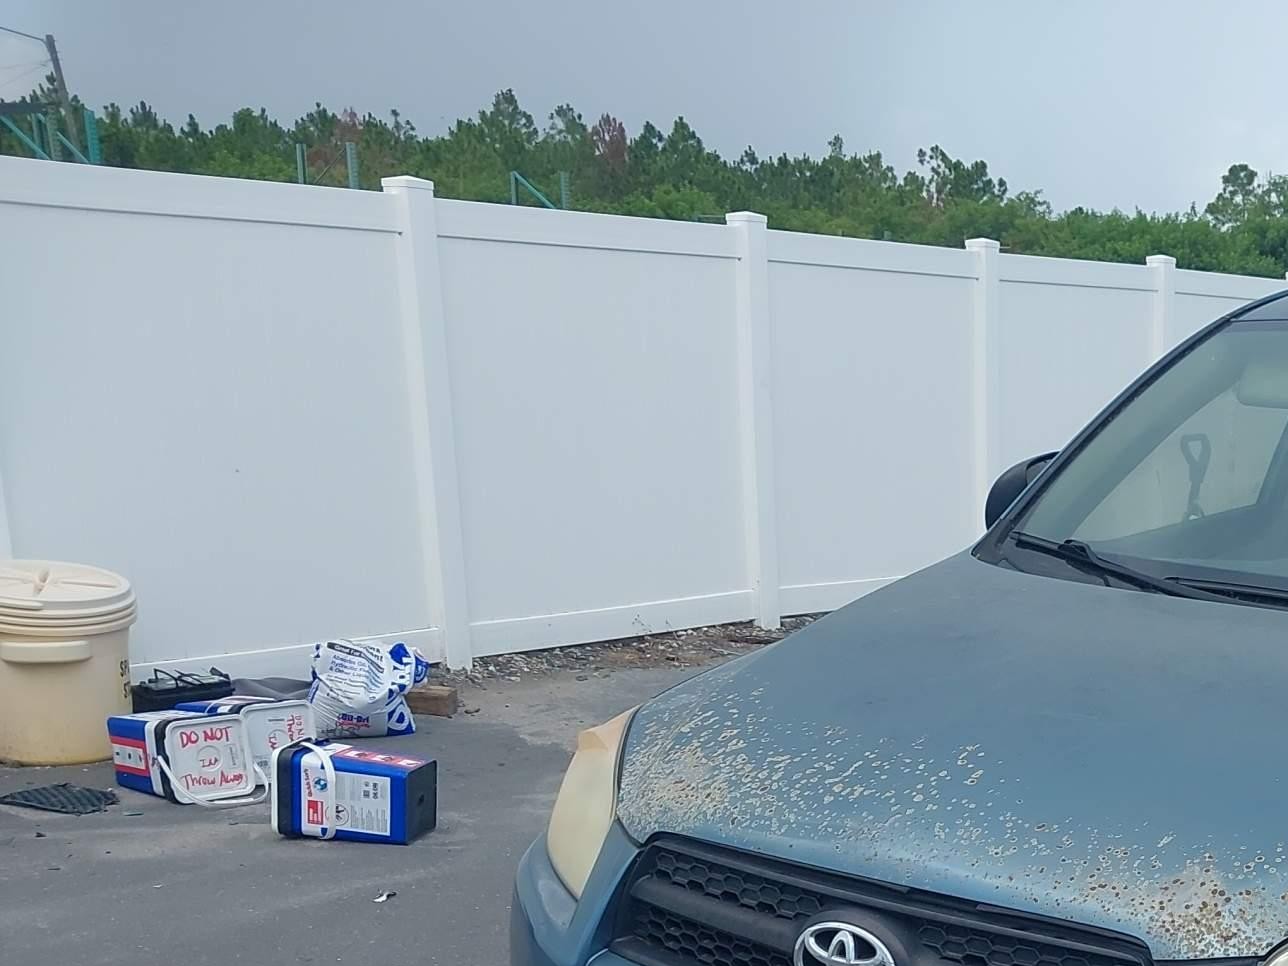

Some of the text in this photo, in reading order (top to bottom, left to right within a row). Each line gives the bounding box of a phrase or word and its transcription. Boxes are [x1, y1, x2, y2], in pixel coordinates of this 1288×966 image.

[179, 726, 233, 749] DO NOT
[182, 770, 244, 791] Throw Away
